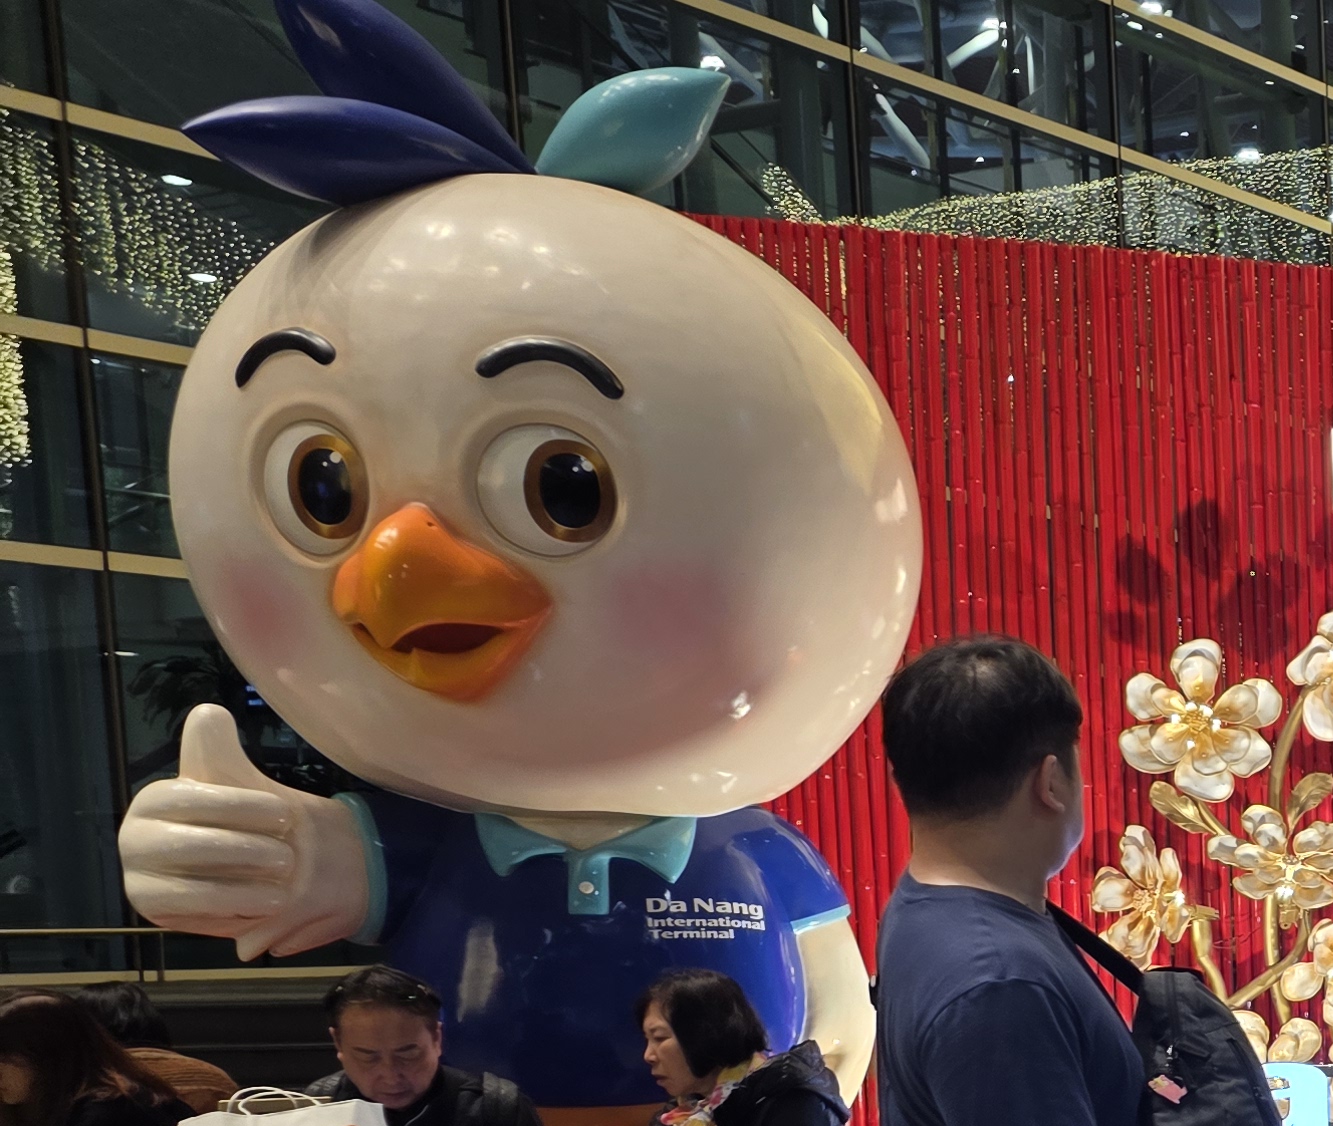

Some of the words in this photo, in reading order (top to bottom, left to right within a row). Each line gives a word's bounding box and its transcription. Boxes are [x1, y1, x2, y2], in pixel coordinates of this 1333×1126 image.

[693, 897, 764, 920] Nang
[645, 915, 766, 931] International
[648, 927, 735, 940] Terminal
